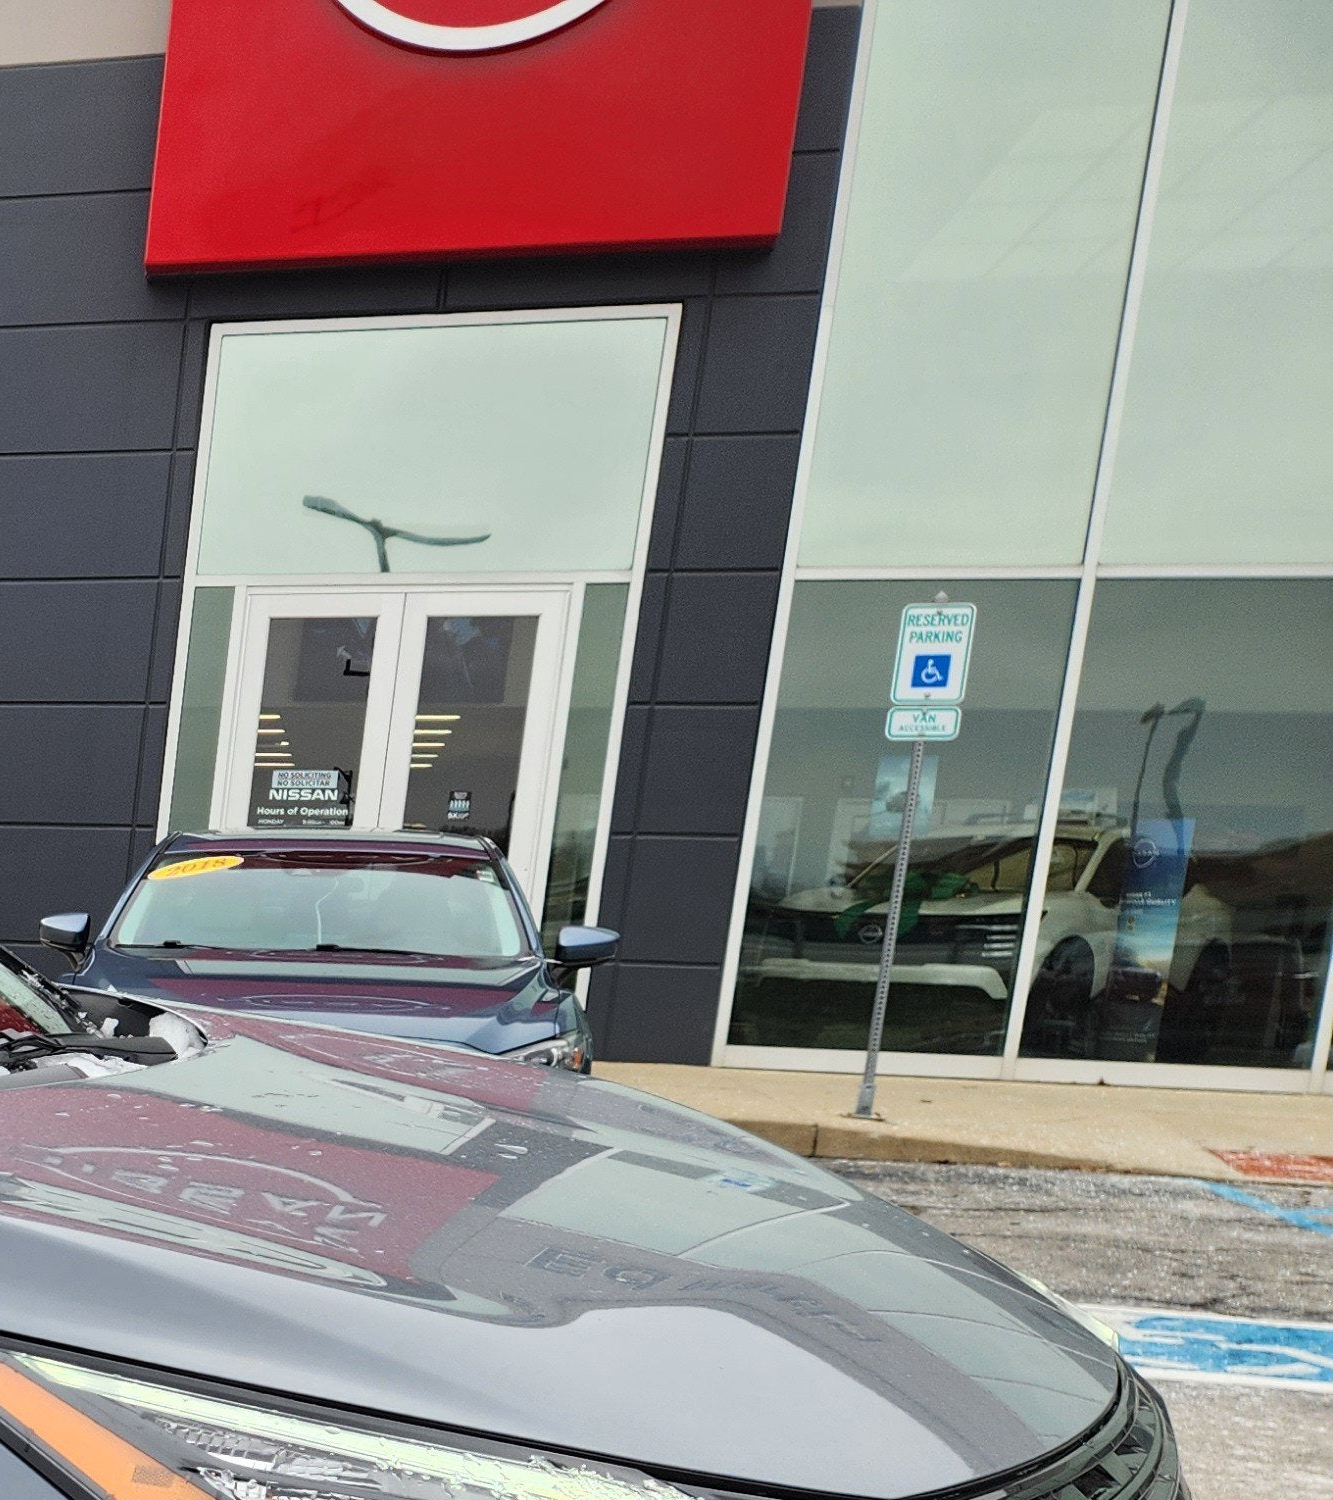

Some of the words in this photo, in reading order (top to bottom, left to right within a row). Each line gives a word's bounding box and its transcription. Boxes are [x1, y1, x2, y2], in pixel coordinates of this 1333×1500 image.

[907, 613, 970, 627] RESERVED
[909, 631, 963, 643] PARKING
[913, 714, 936, 723] VAN
[277, 772, 289, 780] NO
[290, 772, 332, 780] SOLICITING
[268, 789, 339, 801] NISSAN
[257, 807, 285, 816] Hours
[287, 807, 298, 816] of
[300, 807, 349, 817] Operation
